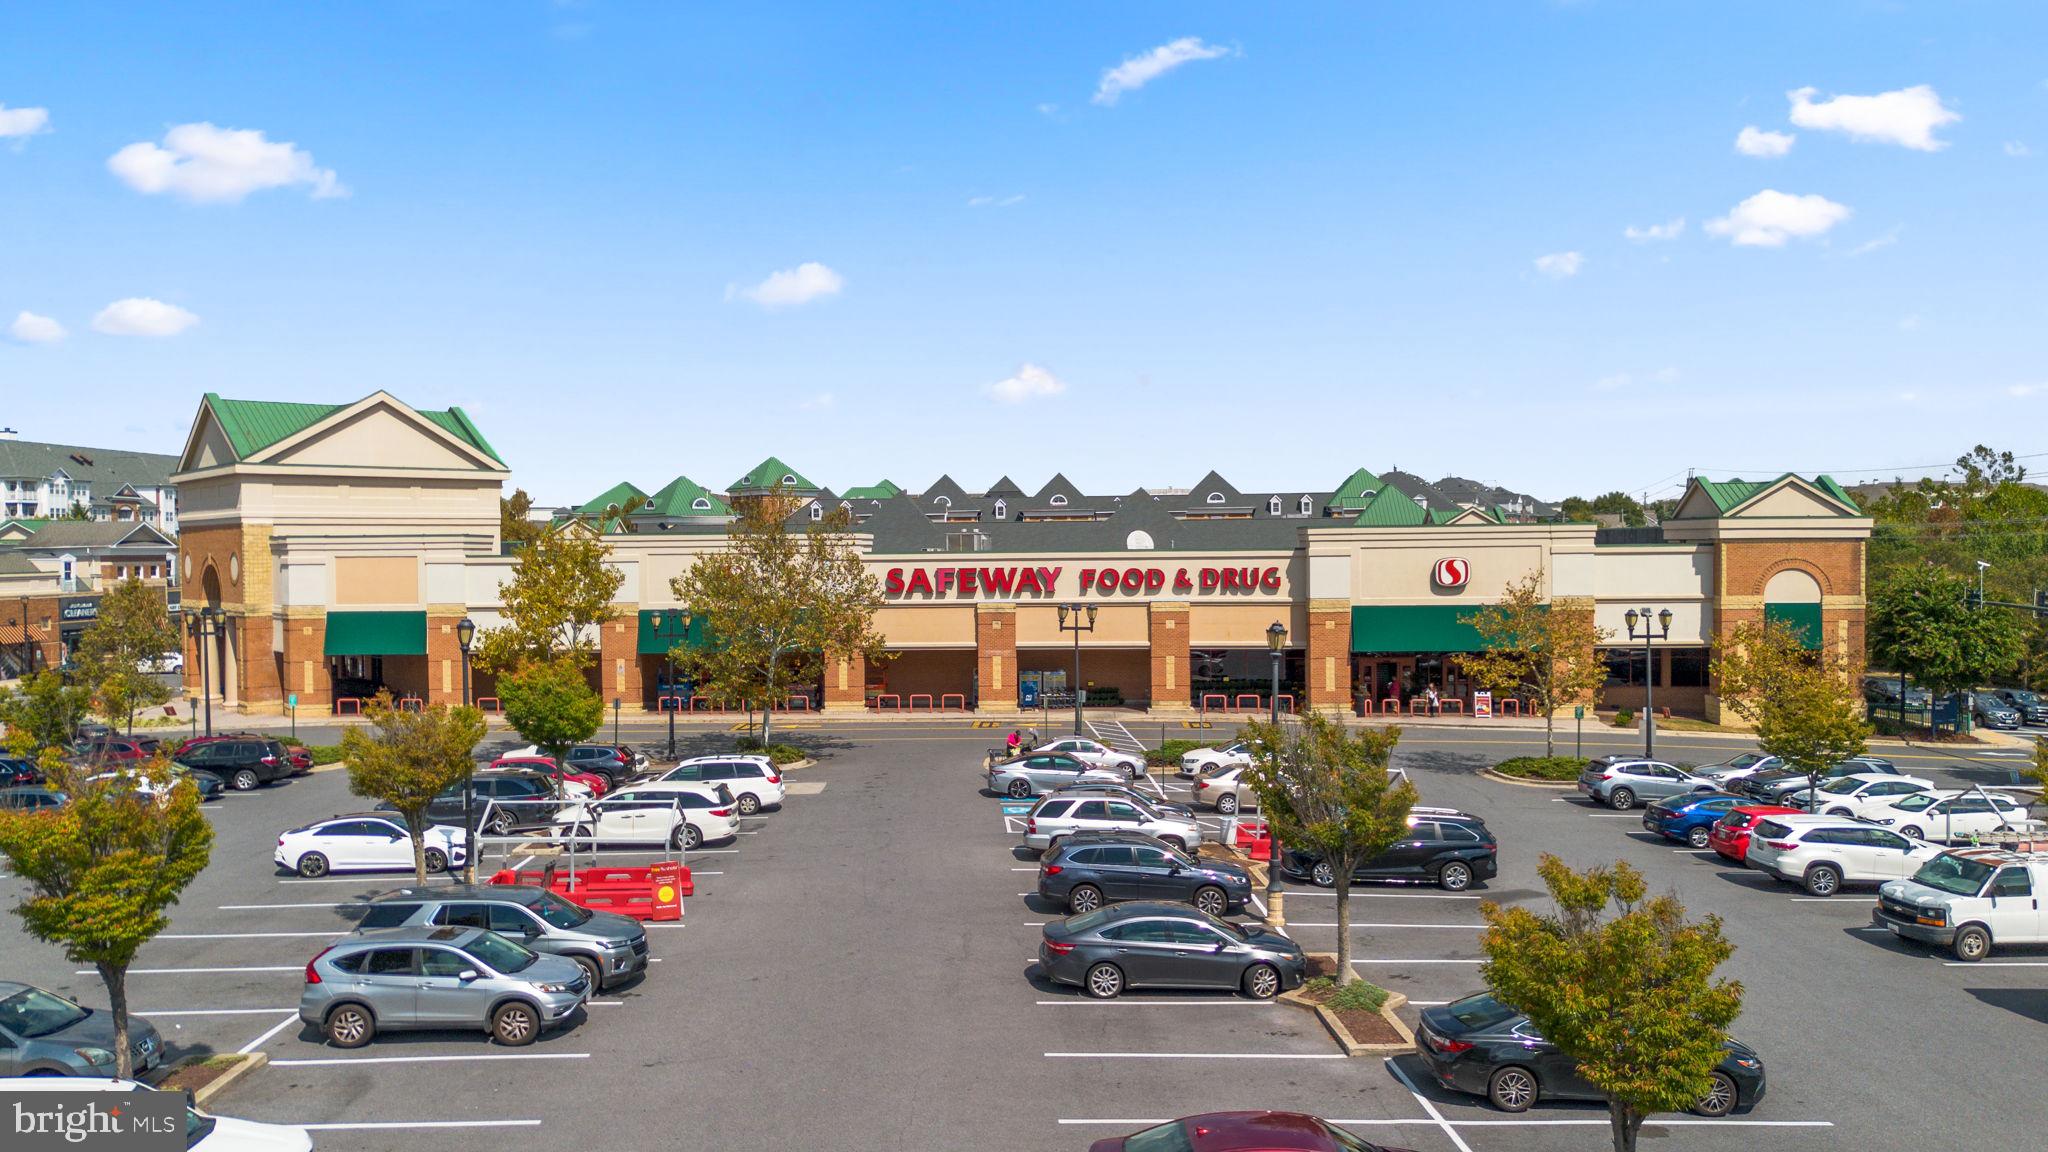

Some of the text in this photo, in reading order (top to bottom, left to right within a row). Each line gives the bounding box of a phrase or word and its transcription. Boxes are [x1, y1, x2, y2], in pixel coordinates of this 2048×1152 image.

[886, 566, 1281, 594] SAFEWAY FOOD & DRUG
